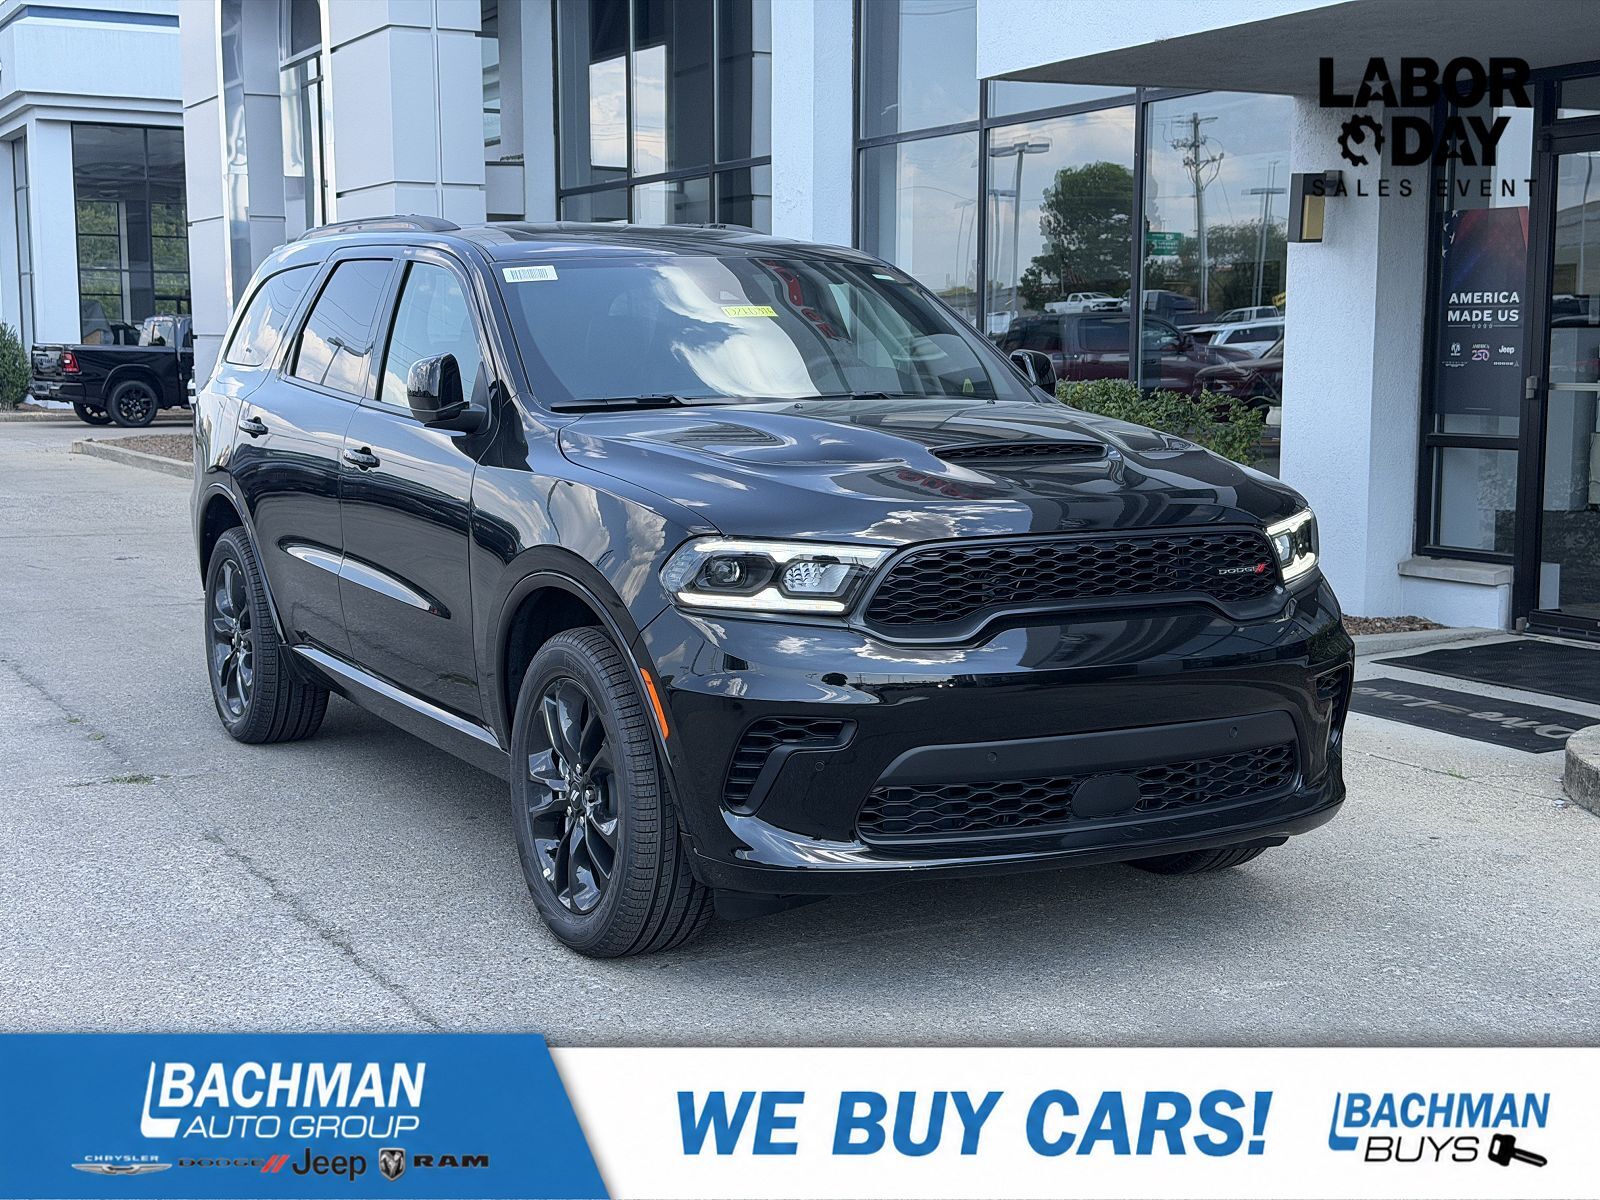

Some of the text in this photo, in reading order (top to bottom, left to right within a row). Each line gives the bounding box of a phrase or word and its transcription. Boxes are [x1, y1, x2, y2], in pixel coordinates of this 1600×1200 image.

[1448, 291, 1520, 304] AMERICA
[1447, 309, 1520, 322] MADE US
[1498, 344, 1515, 355] Jeep
